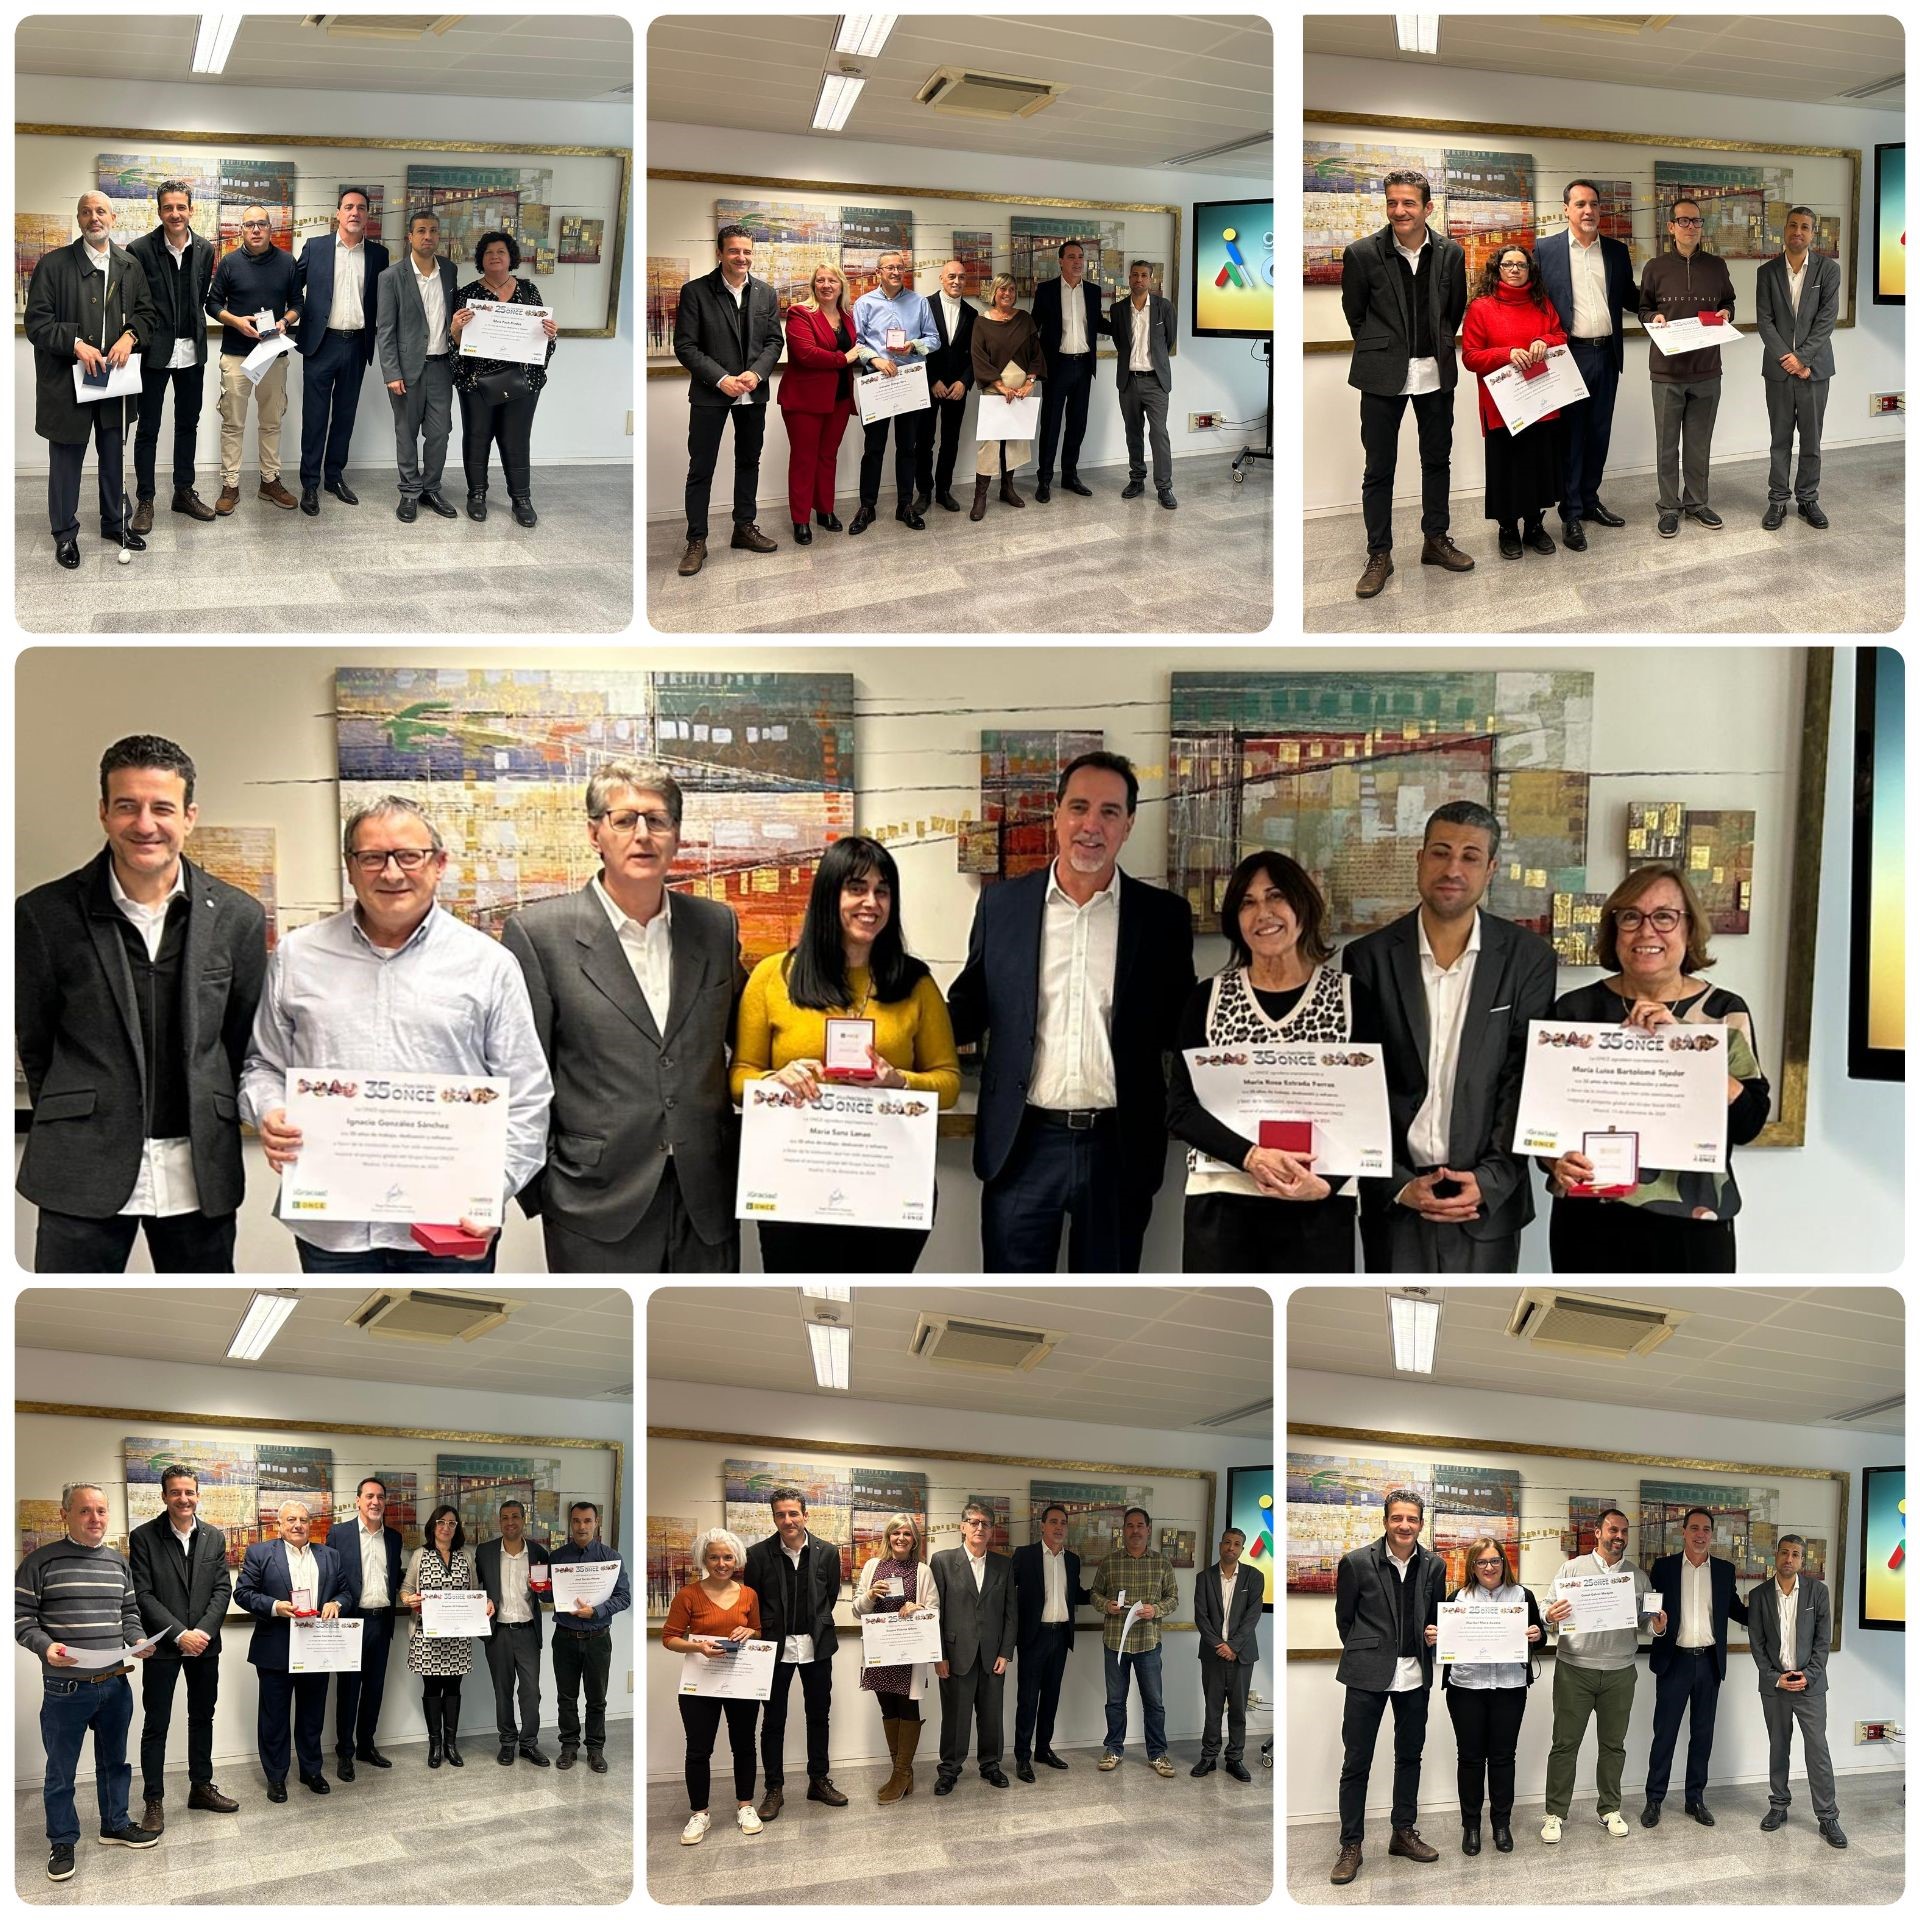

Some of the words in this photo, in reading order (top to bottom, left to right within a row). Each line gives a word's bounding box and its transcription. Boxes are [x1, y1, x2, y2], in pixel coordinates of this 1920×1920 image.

[1598, 1032, 1624, 1050] 35
[1624, 1039, 1665, 1051] ONCE
[1252, 1050, 1277, 1065] 35
[1278, 1055, 1317, 1067] ONCE
[1595, 1066, 1615, 1075] Luisa
[1616, 1068, 1656, 1076] Bartolomé
[1658, 1069, 1686, 1078] Tejedor
[364, 1080, 391, 1100] 35
[391, 1088, 436, 1103] ONCE
[836, 1100, 874, 1114] ONCE
[346, 1117, 377, 1128] Ignacio
[377, 1118, 416, 1129] González
[416, 1119, 450, 1130] Sánchez
[1533, 1140, 1556, 1149] ONCE
[302, 1201, 327, 1210] ONCE
